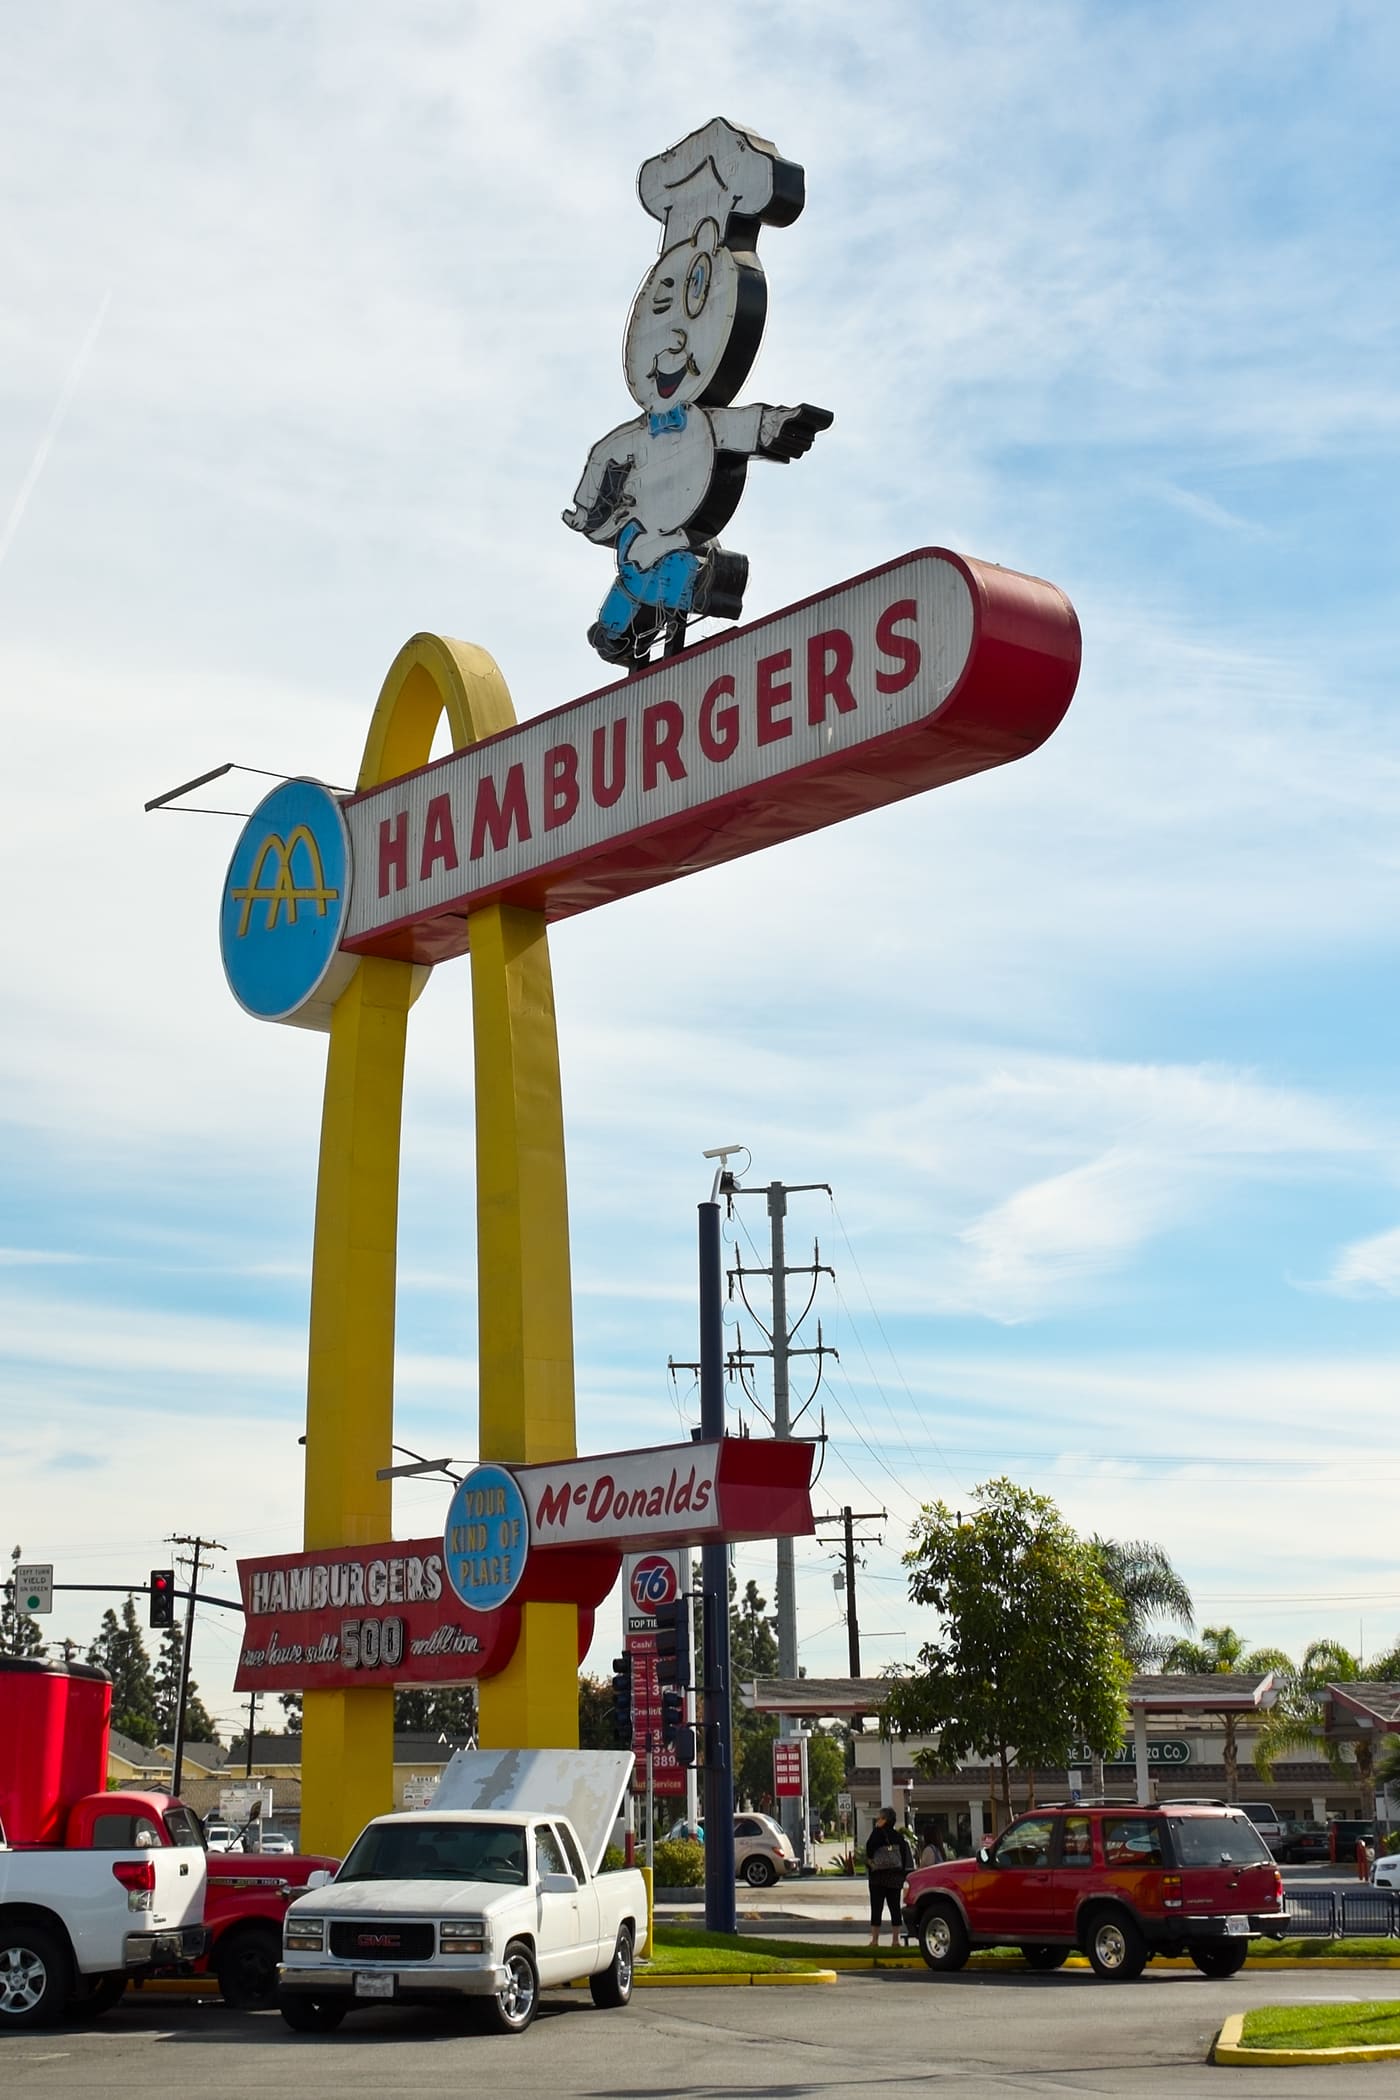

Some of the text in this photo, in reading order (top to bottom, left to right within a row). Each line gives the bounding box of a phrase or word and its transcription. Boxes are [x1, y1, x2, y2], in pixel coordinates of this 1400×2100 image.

[378, 599, 922, 899] HAMBURGERS
[466, 1488, 506, 1518] YOUR
[535, 1464, 712, 1530] McDonalds
[452, 1519, 520, 1553] KIND OF
[251, 1554, 442, 1615] HAMBURGERS
[461, 1554, 511, 1588] PLACE
[634, 1566, 669, 1602] 76
[630, 1618, 645, 1628] TOP
[269, 1631, 302, 1665] have
[341, 1616, 402, 1669] 500
[1163, 1744, 1183, 1759] Co.
[358, 1934, 401, 1947] GMC
